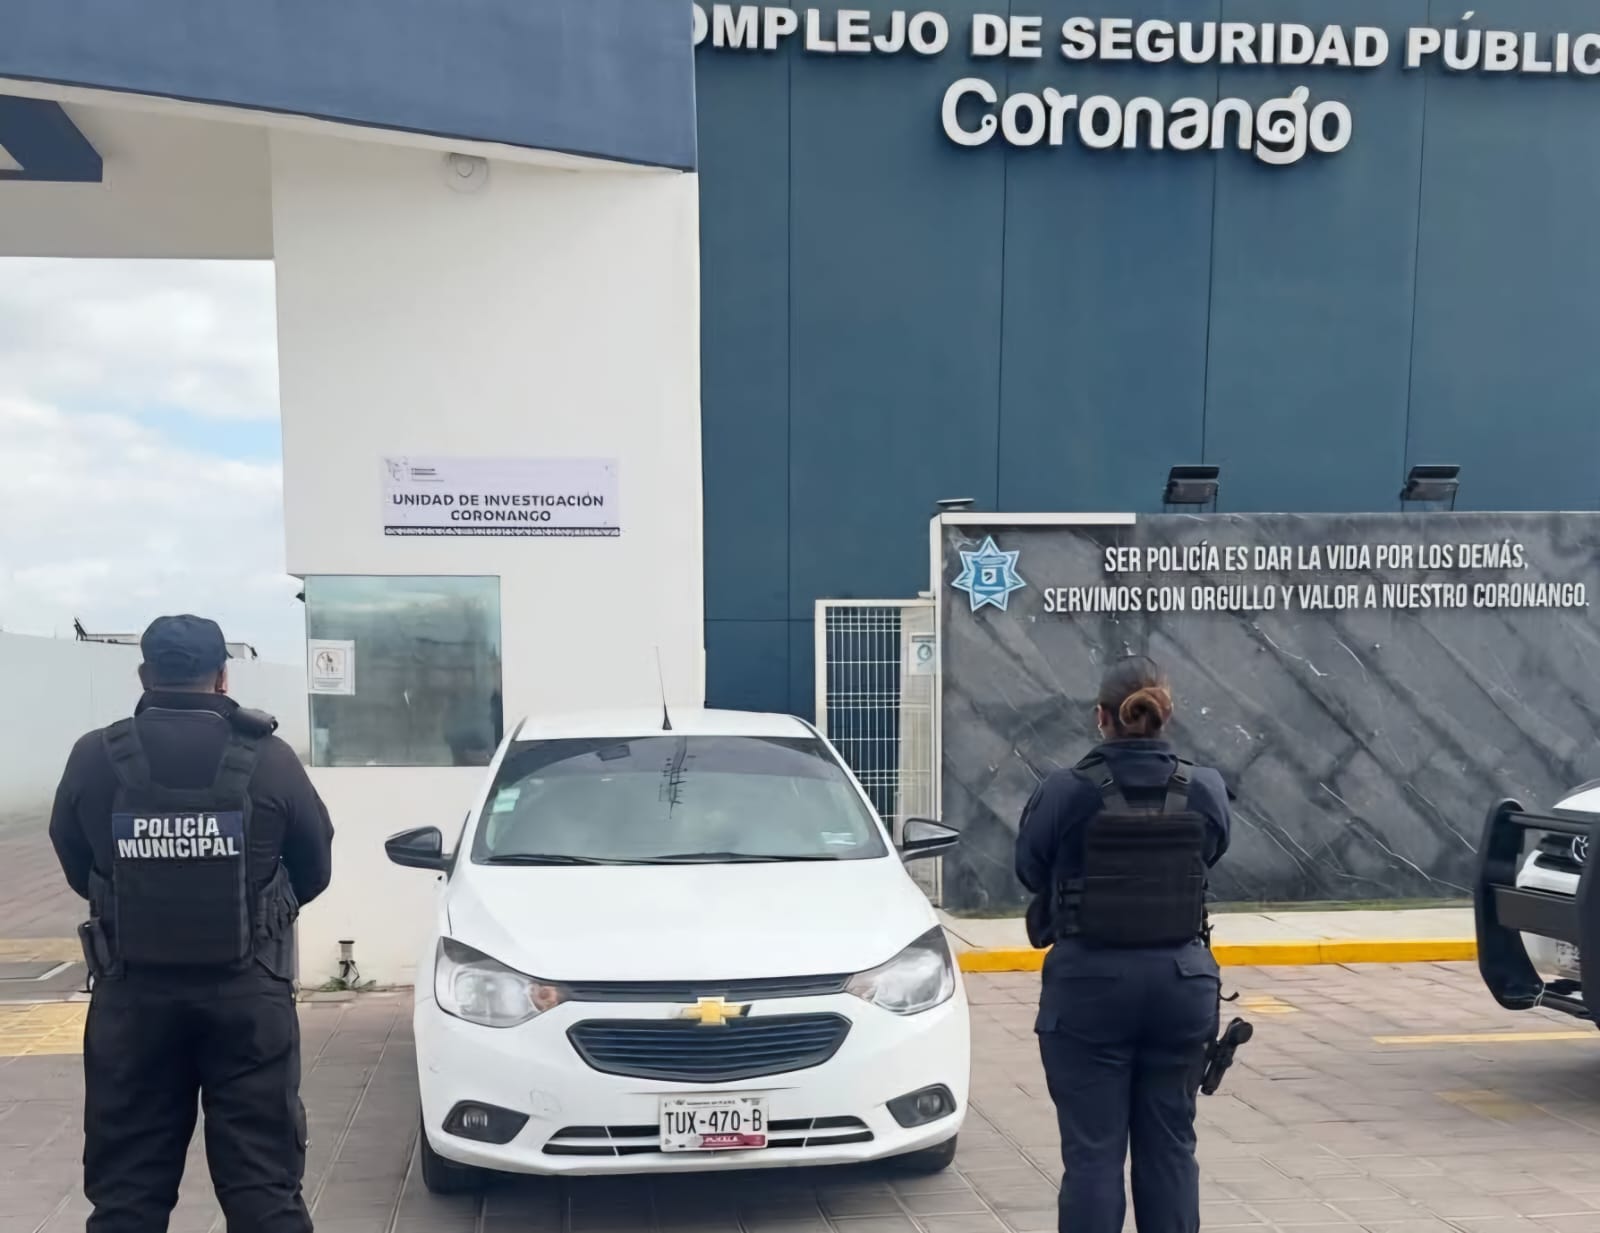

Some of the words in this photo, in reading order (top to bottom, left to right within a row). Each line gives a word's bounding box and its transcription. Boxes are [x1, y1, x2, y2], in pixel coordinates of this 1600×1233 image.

[971, 13, 1042, 58] DE
[1061, 16, 1389, 67] SEGURIDAD
[942, 77, 1353, 165] Coronango
[393, 493, 454, 506] UNIDAD
[459, 494, 480, 506] DE
[484, 492, 604, 507] INVESTIGACIÓN
[450, 509, 552, 522] CORONANGO
[1104, 546, 1142, 572] SER
[1147, 540, 1221, 572] POLICÍA
[1225, 546, 1249, 571] ES
[1254, 546, 1293, 570] DAR
[1298, 545, 1322, 570] LA
[1326, 544, 1371, 570] VIDA
[1376, 544, 1414, 569] POR
[1418, 543, 1454, 569] LOS
[1458, 538, 1529, 570] DEMÁS,
[1043, 586, 1142, 613] SERVIMOS
[1146, 586, 1186, 612] CON
[1191, 584, 1276, 611] ORGULLO
[1281, 585, 1294, 610] Y
[1298, 584, 1359, 610] VALOR
[1363, 583, 1377, 609] A
[1382, 583, 1466, 608] NUESTRO
[1472, 582, 1590, 608] CORONANGO.
[133, 812, 220, 838] POLICÍA
[117, 836, 241, 859] MUNICIPAL
[664, 1108, 762, 1135] TUX-470-B
